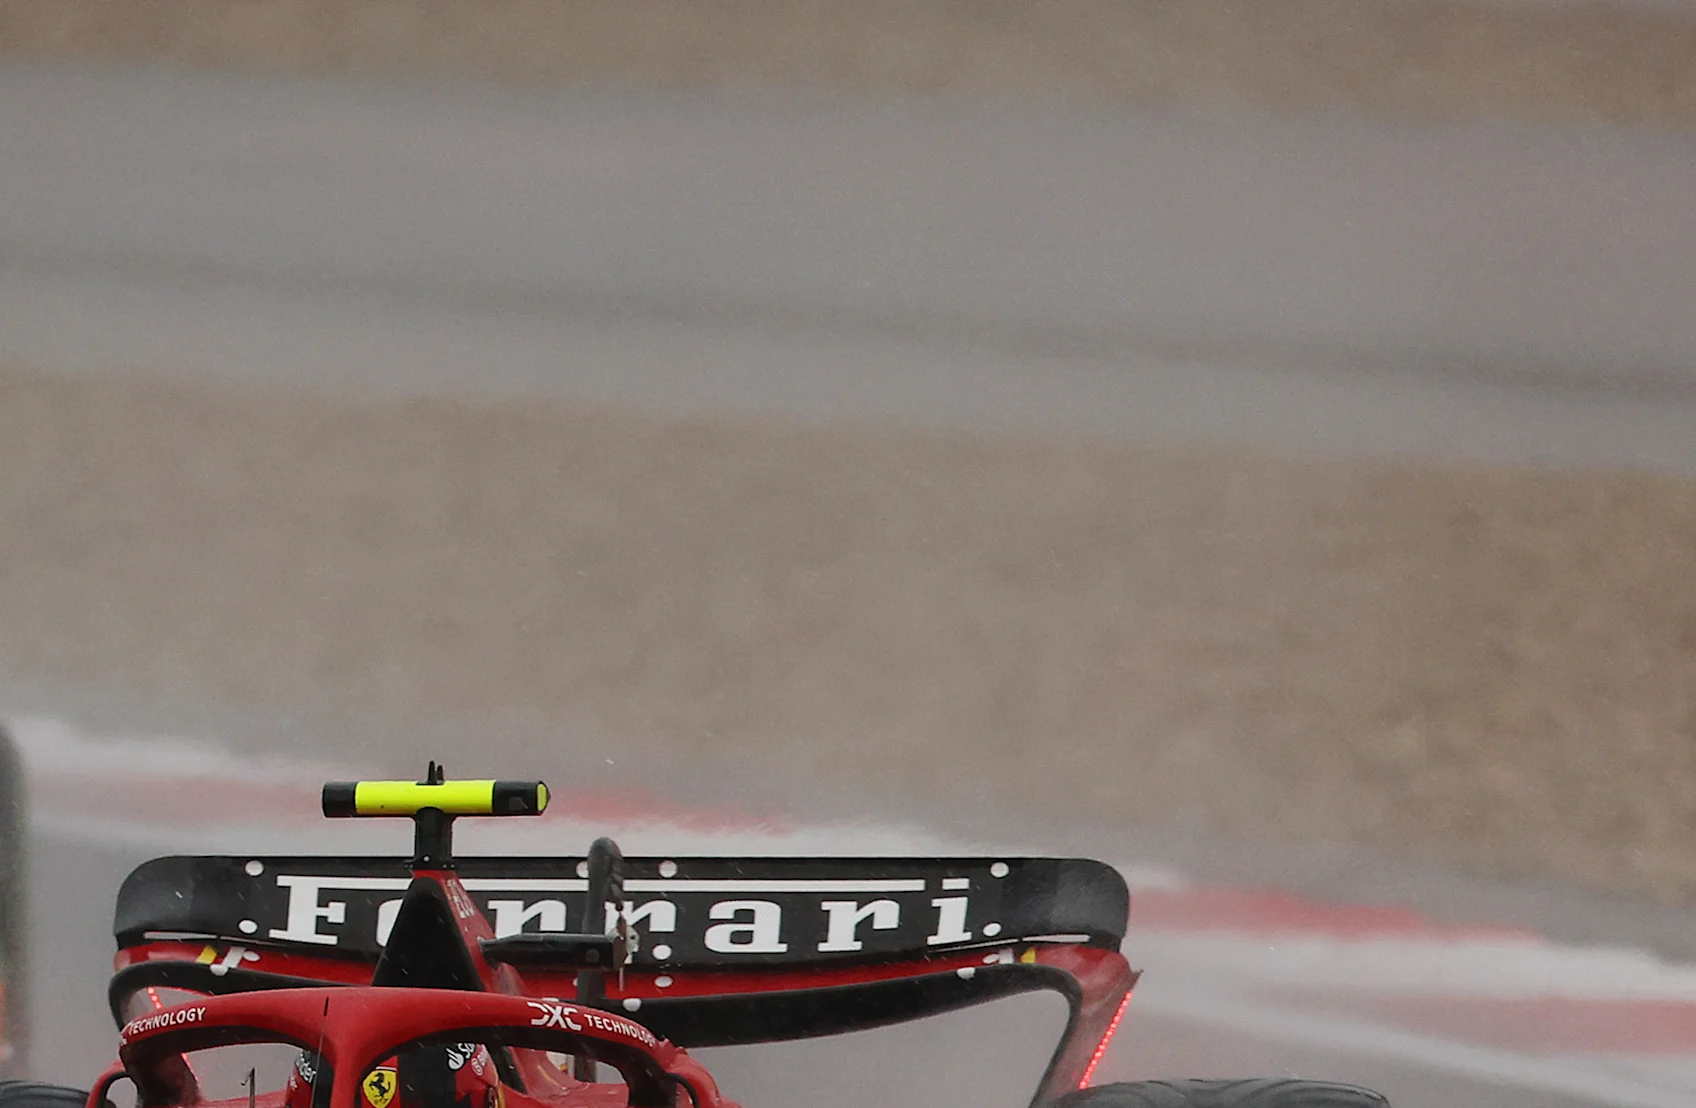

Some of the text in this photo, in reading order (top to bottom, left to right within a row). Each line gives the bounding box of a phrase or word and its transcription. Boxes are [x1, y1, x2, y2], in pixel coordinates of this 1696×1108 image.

[269, 875, 972, 953] Frrari
[128, 1007, 206, 1036] TECHNOLOGY
[527, 1001, 656, 1048] DXC TECHNOLOG
